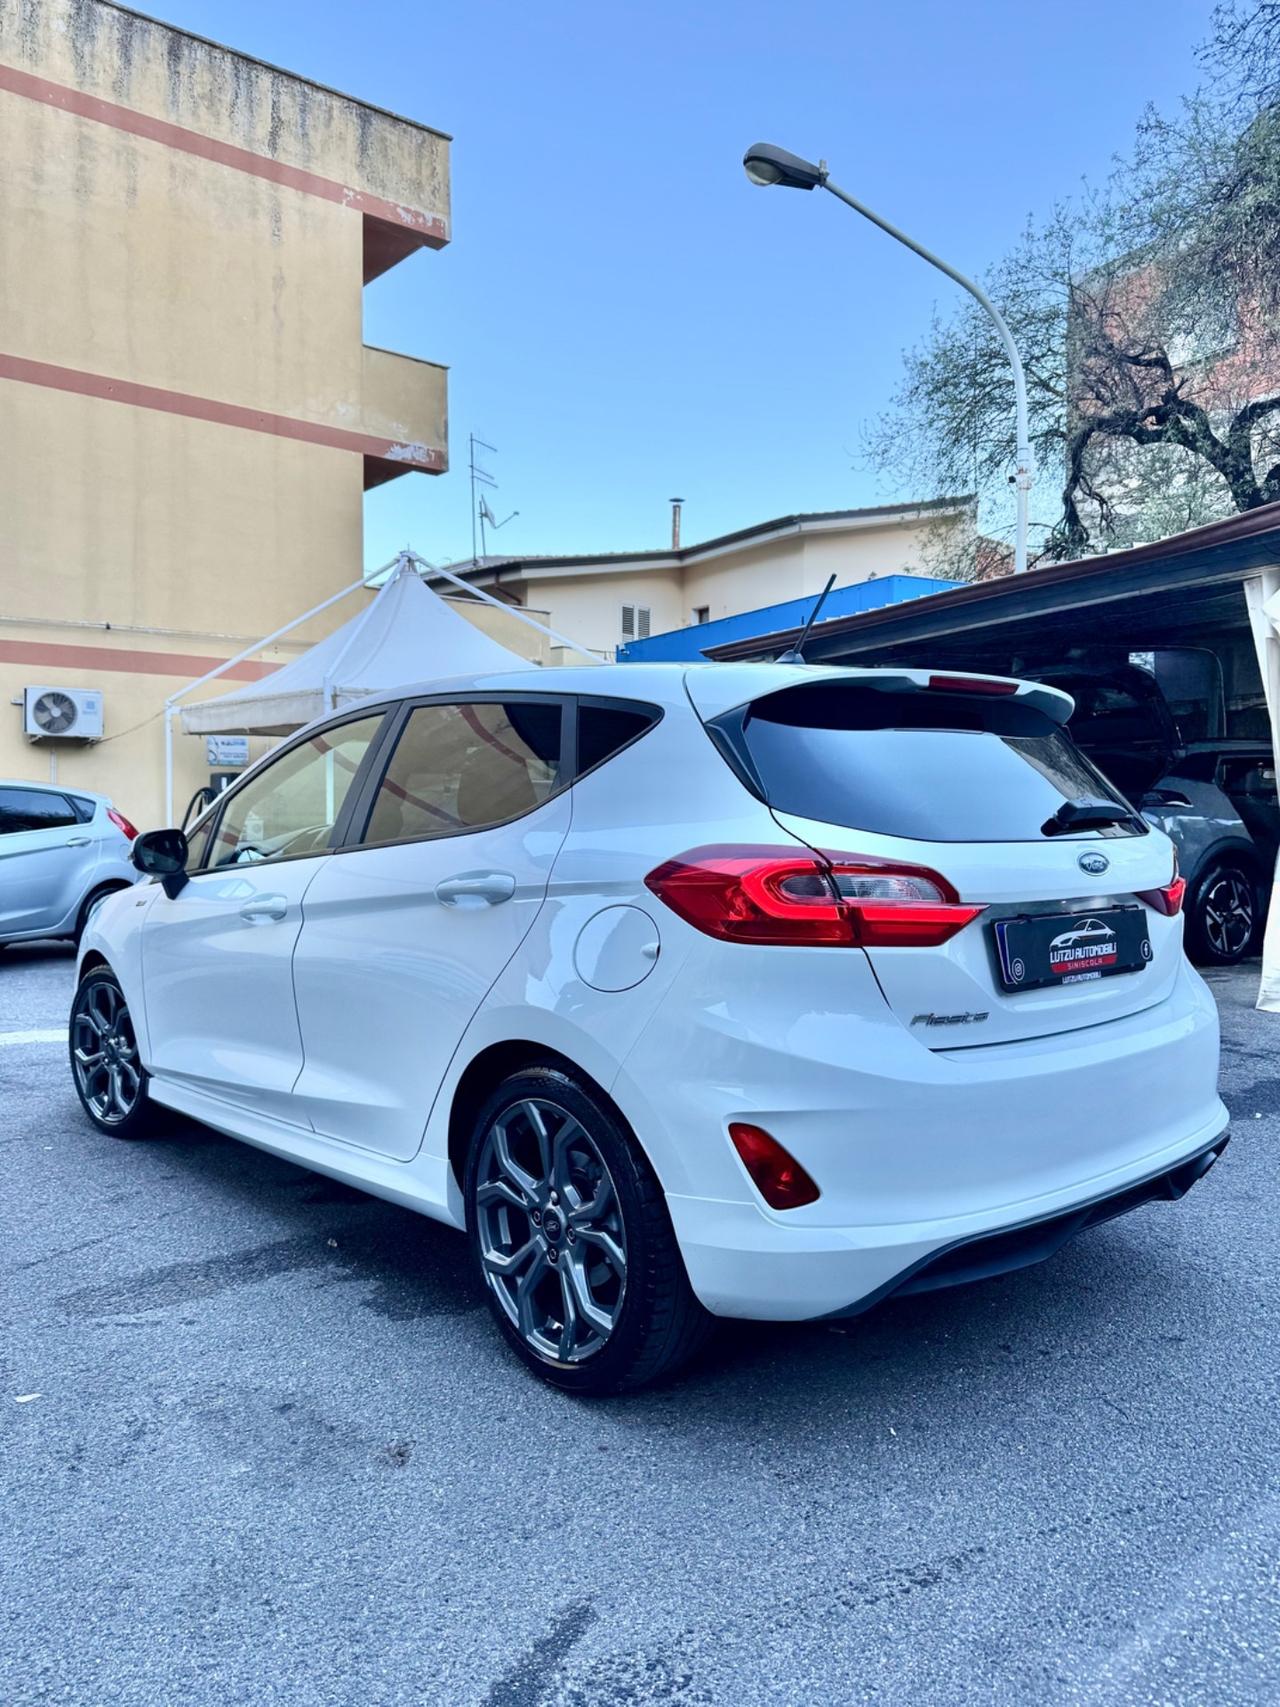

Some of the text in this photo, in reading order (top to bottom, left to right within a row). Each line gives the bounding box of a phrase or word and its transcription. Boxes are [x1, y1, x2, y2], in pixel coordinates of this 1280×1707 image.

[1050, 943, 1117, 963] LUTZU AUTOMOBILI
[1067, 958, 1103, 970] SINISCOLA
[910, 1012, 990, 1027] Fiesta
